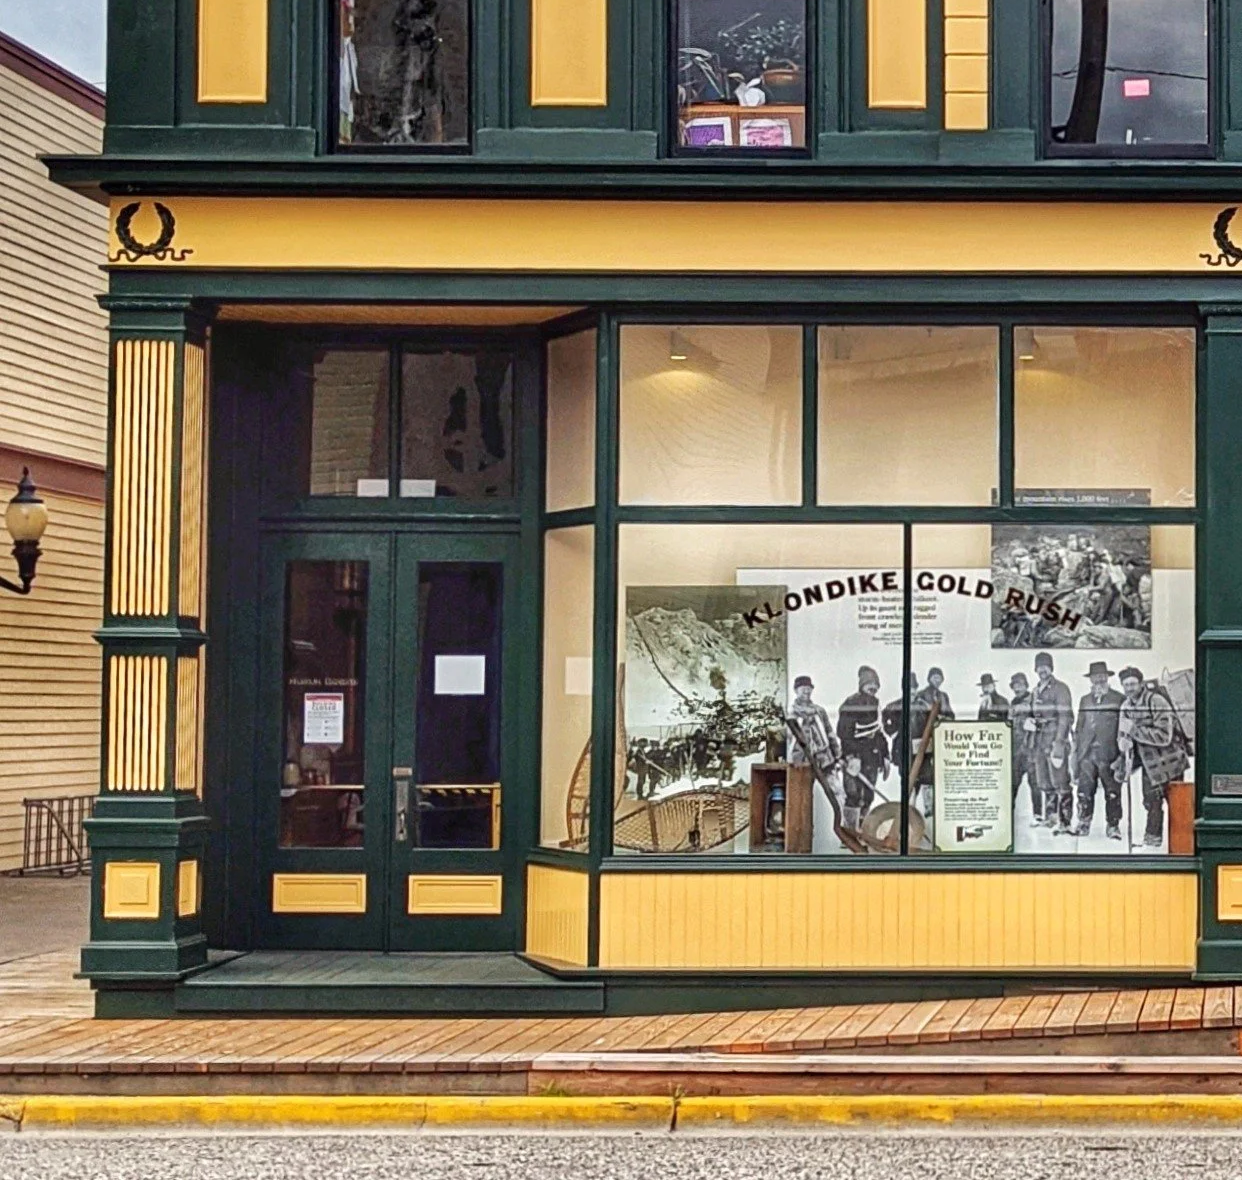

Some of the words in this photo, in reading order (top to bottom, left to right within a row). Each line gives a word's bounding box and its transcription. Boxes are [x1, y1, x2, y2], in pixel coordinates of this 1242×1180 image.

[742, 572, 898, 629] KLONDIKE
[917, 571, 994, 599] GOLD
[1005, 587, 1082, 631] RUSH
[944, 730, 974, 740] How
[979, 730, 1003, 740] Far
